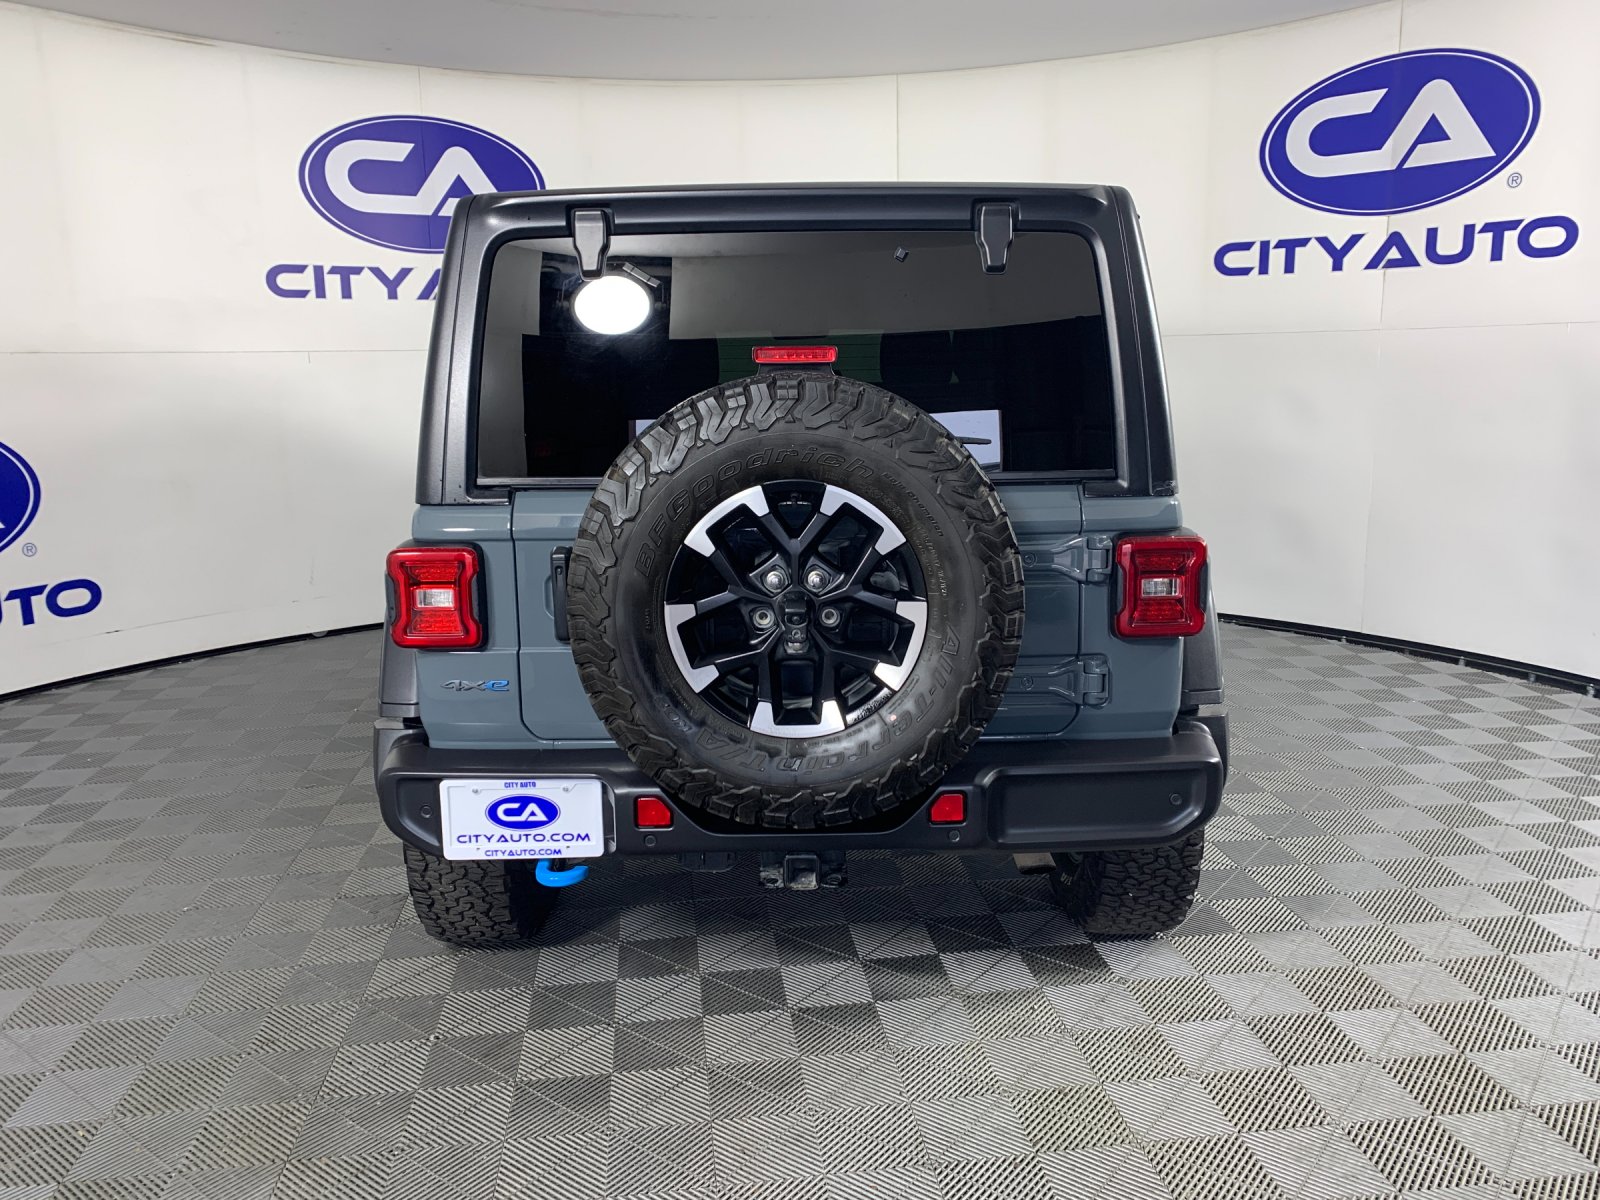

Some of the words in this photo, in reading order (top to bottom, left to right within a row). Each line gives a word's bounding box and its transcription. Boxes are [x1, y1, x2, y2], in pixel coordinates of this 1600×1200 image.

[1285, 78, 1497, 178] CA
[265, 263, 416, 300] CITY
[504, 781, 519, 789] CITY
[497, 802, 549, 822] CA
[456, 833, 591, 844] CITYAUTO.COM
[485, 848, 562, 857] CITYAUTO.COM
